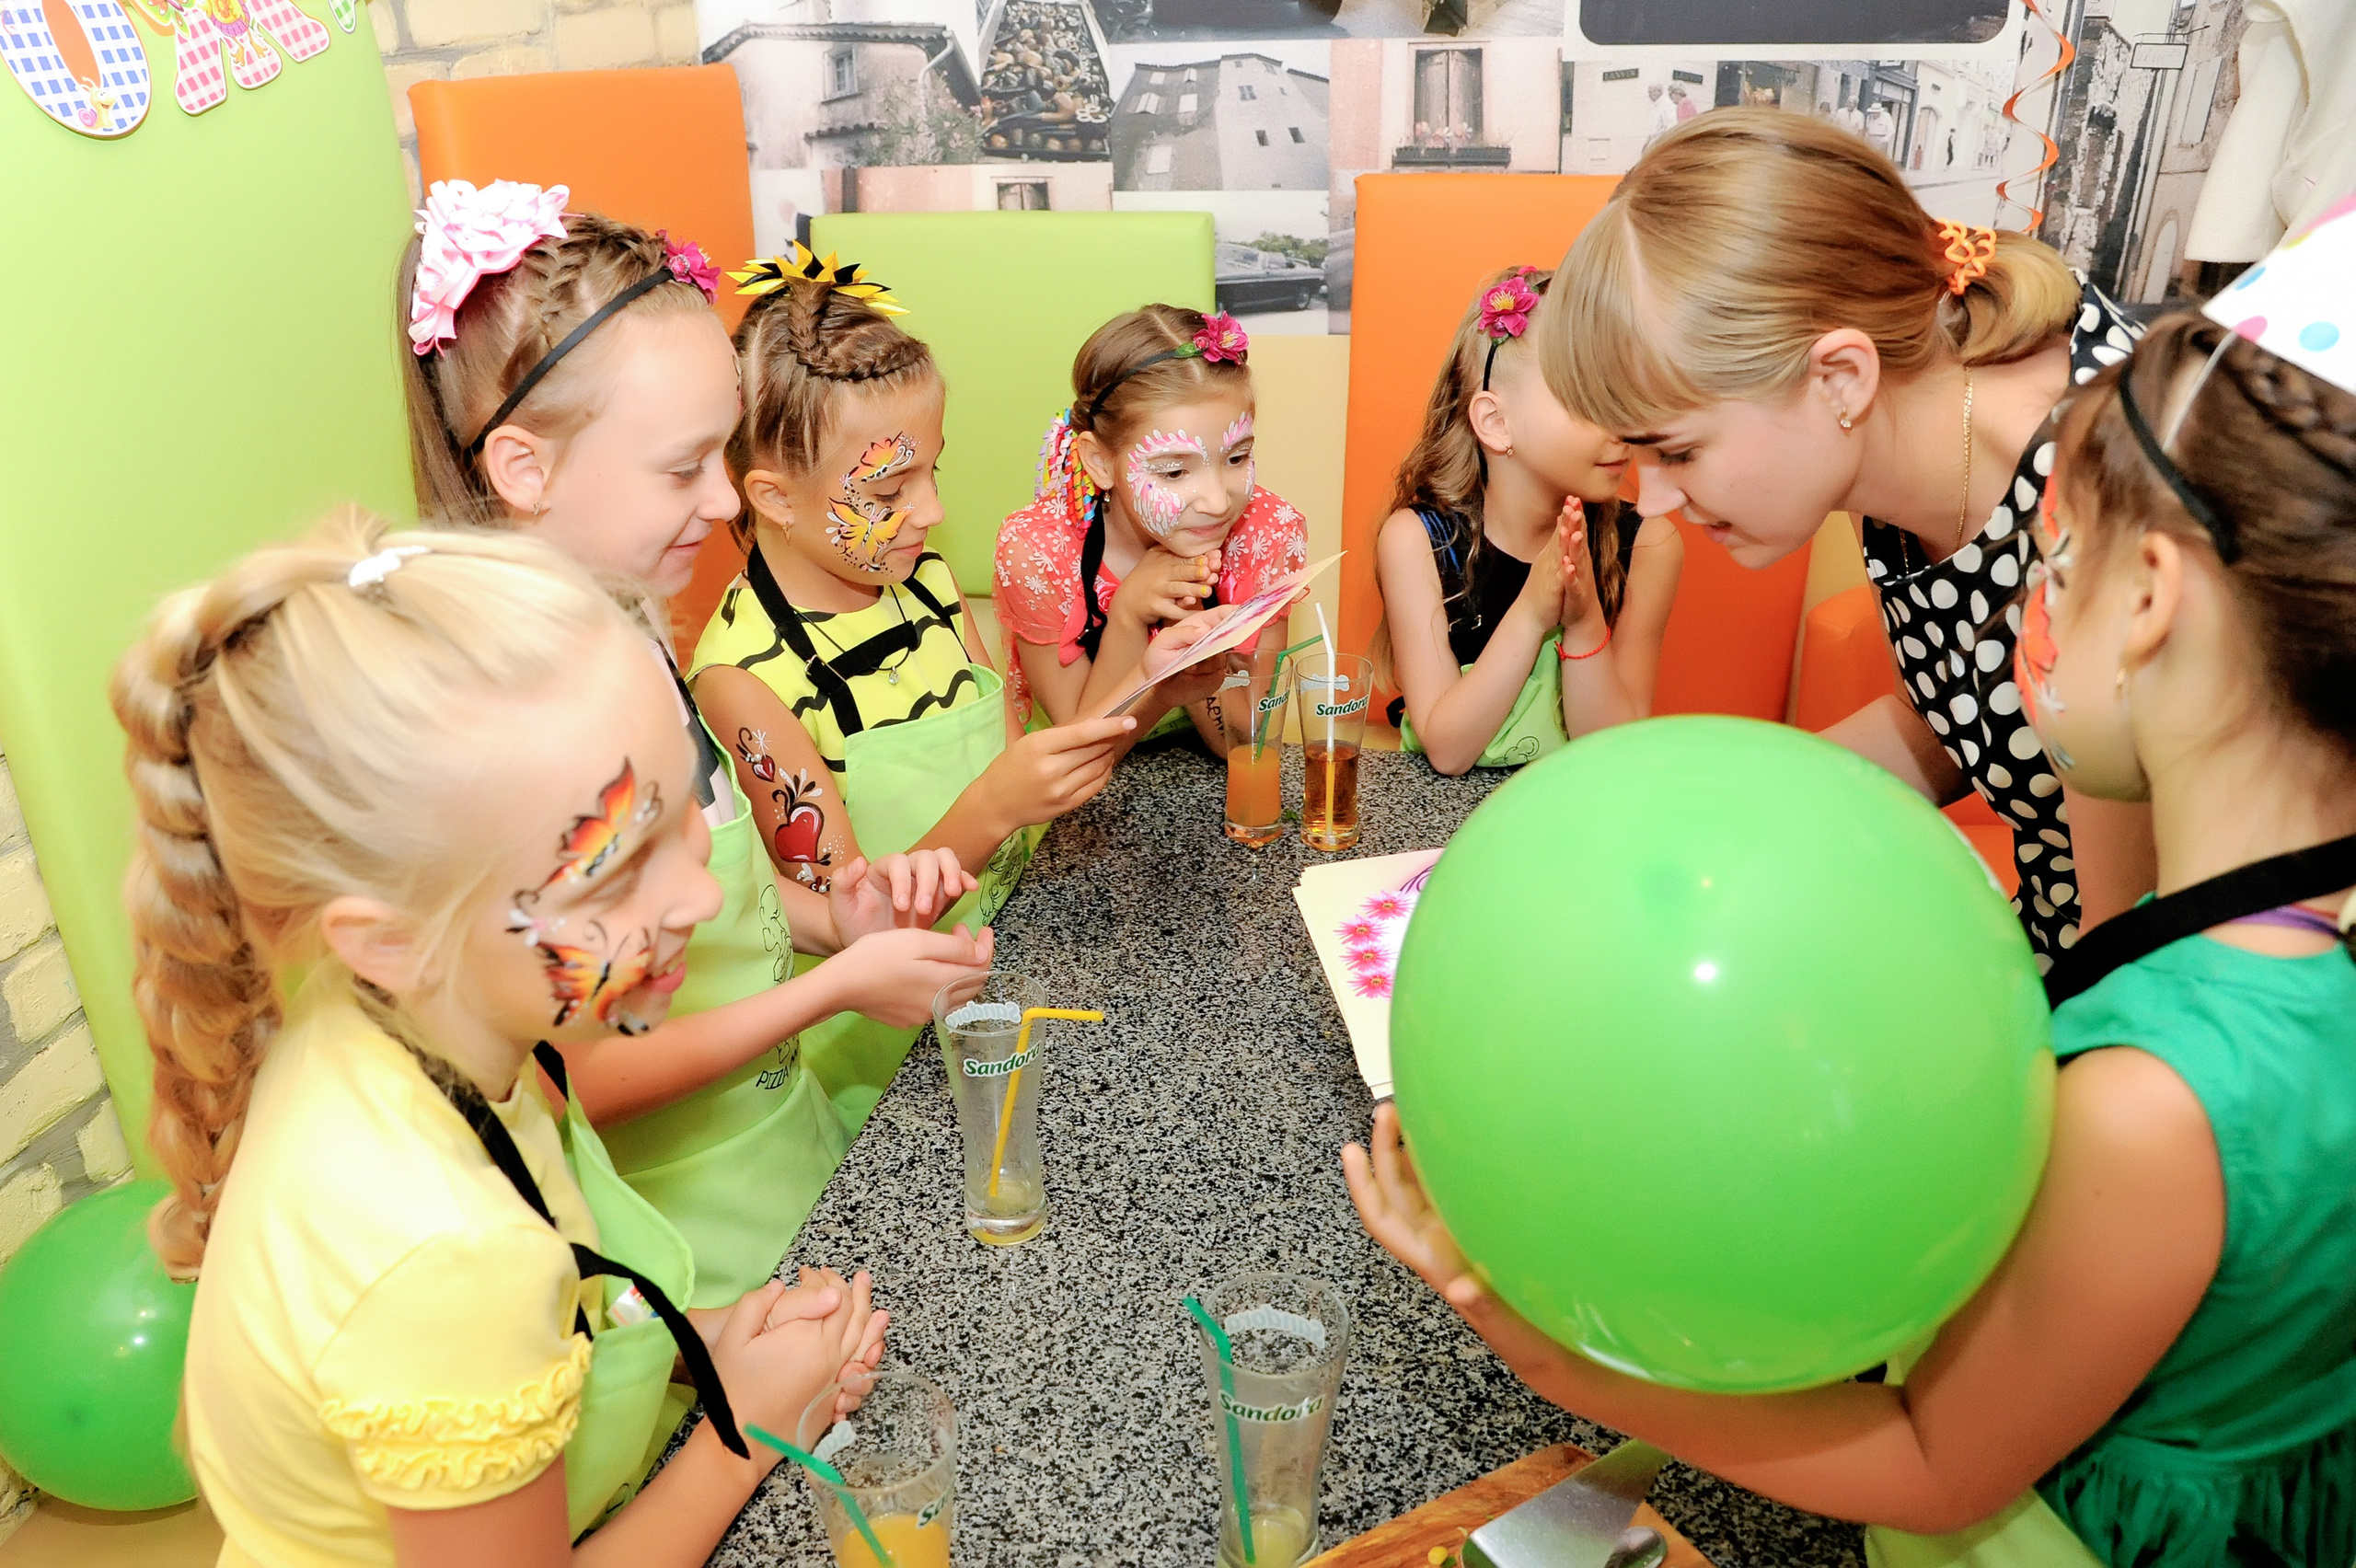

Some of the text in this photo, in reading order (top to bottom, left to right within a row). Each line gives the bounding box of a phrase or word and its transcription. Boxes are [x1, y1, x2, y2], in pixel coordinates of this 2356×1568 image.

[964, 1042, 1041, 1076] Sandora
[756, 1066, 789, 1090] PIZZA
[1219, 1391, 1324, 1422] Sandora
